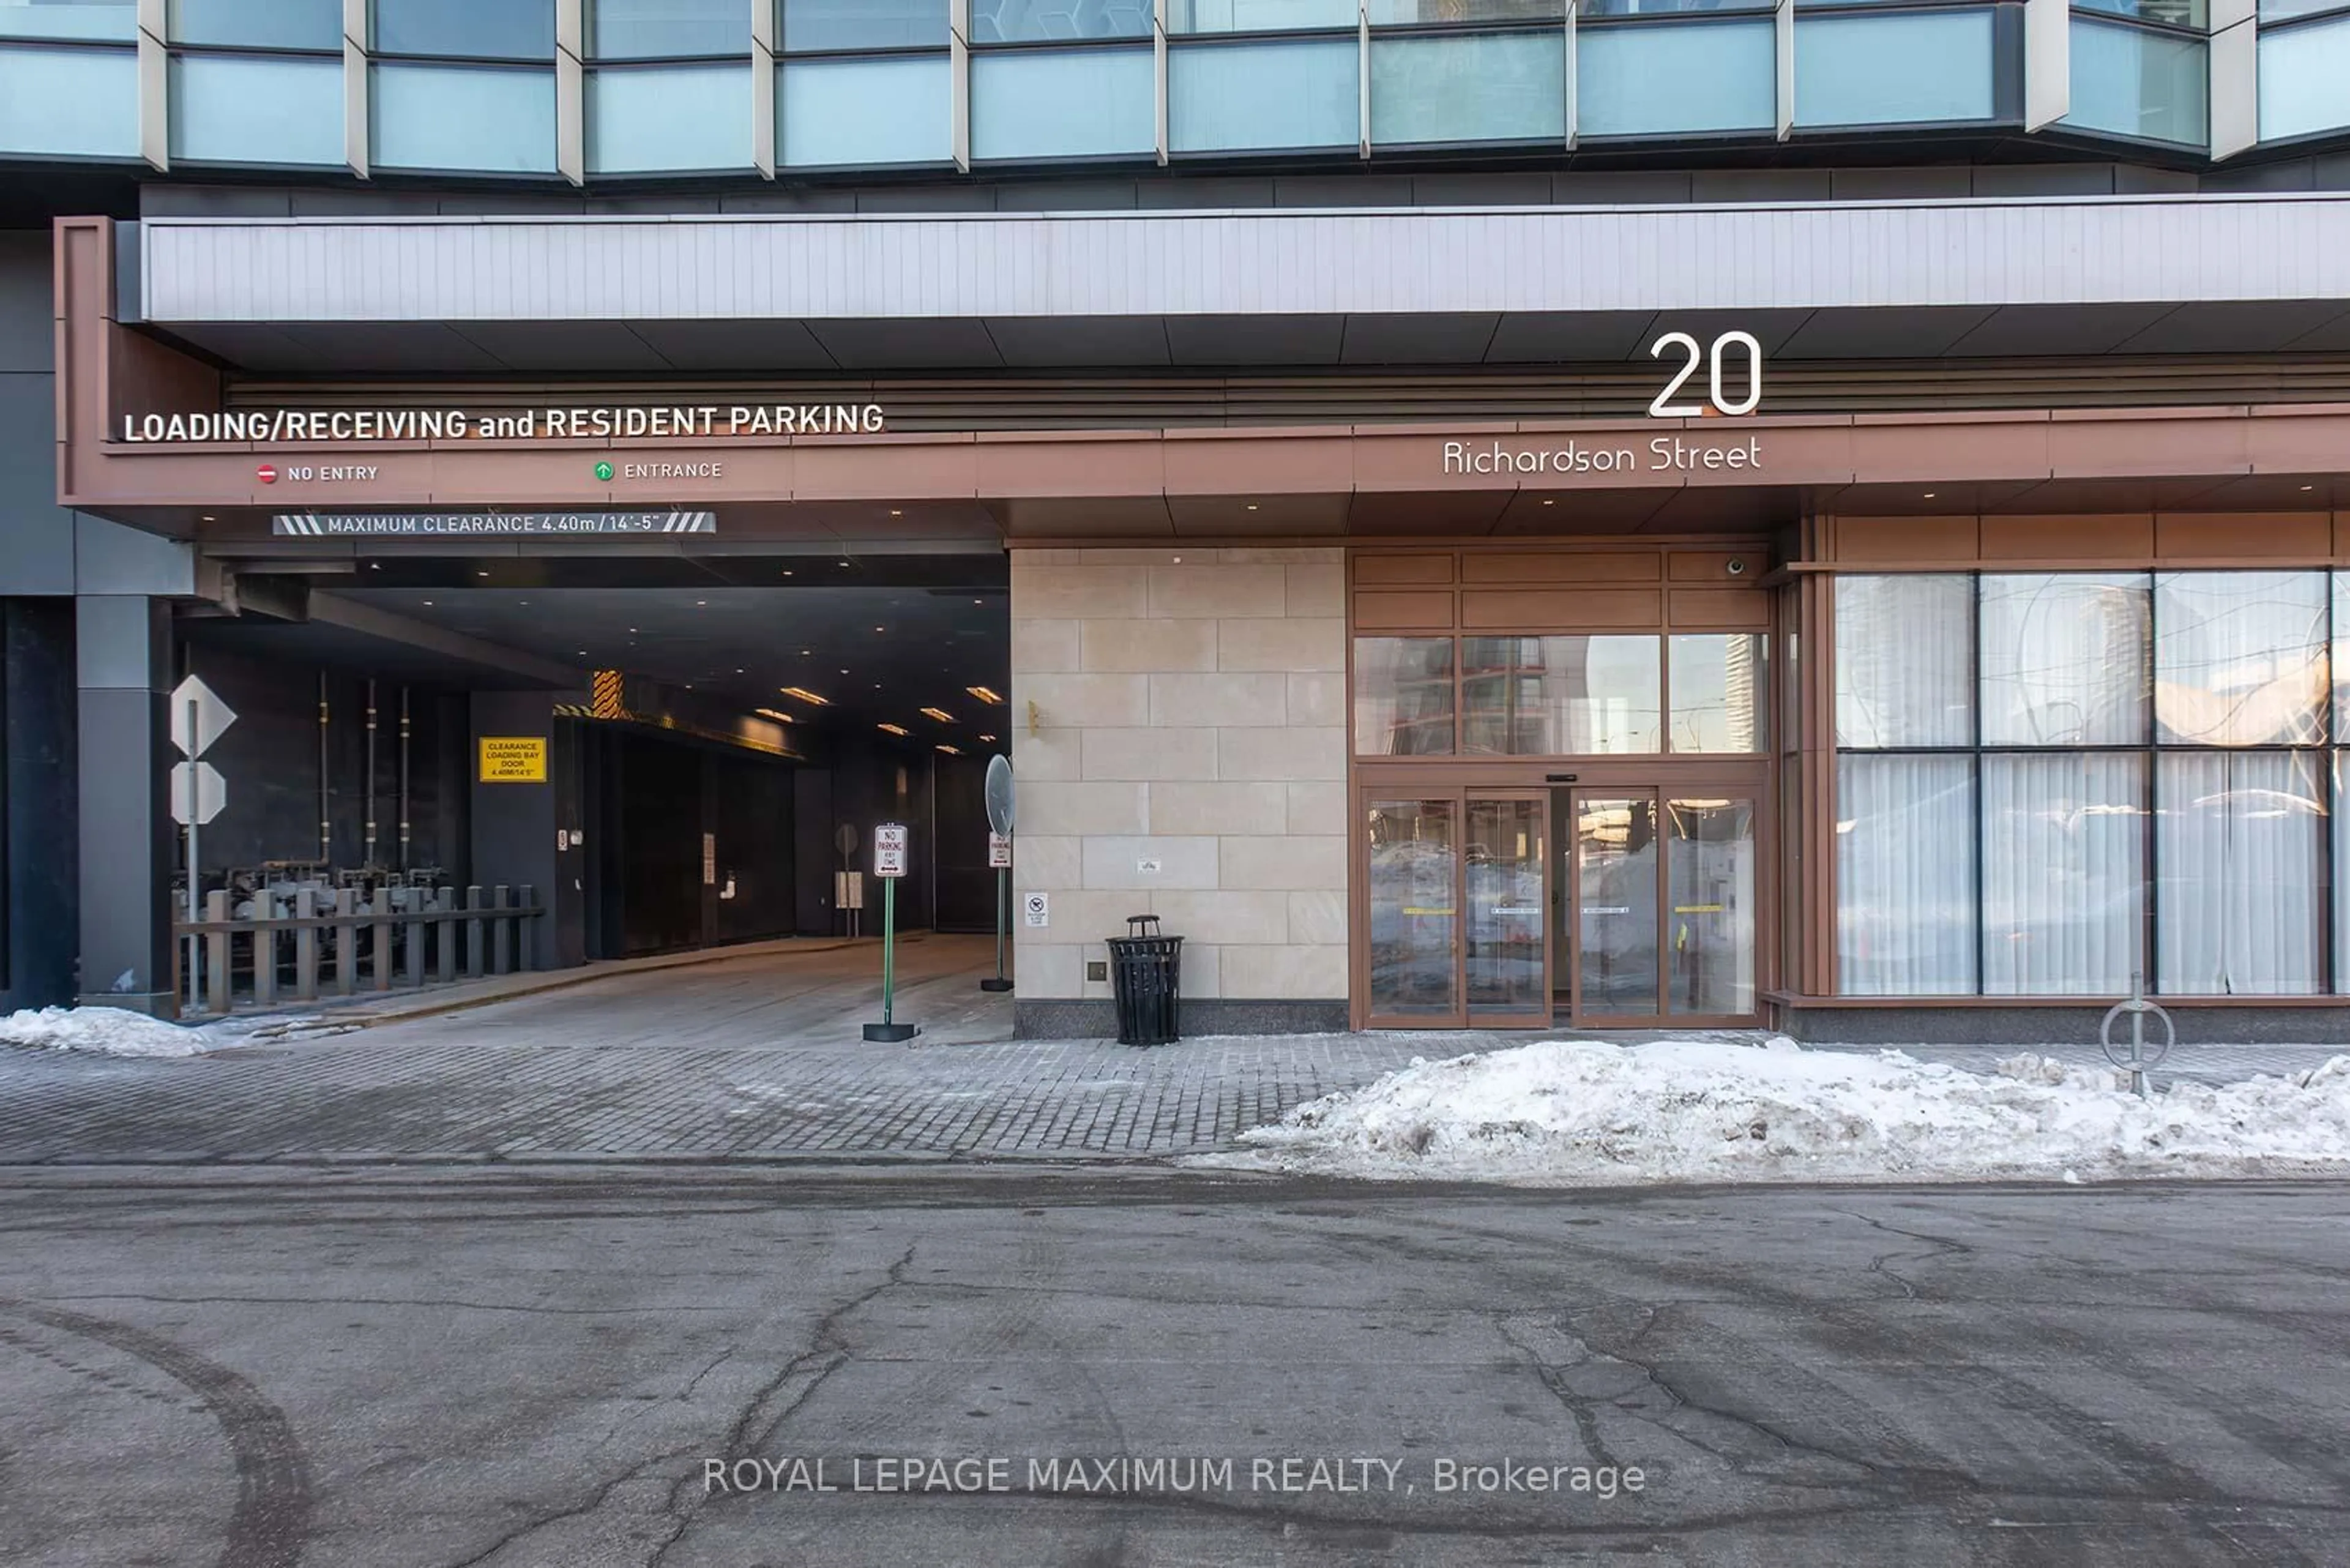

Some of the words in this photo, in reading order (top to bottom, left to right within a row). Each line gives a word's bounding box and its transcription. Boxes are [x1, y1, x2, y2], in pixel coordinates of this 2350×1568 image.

[1649, 330, 1762, 417] 20
[124, 409, 467, 442] LOADING/RECEIVING
[479, 410, 534, 438] and
[546, 407, 718, 436] RESIDENT
[731, 404, 885, 434] PARKING
[1444, 440, 1635, 474] Richardson
[1649, 436, 1761, 470] Street
[288, 466, 313, 480] NO
[320, 466, 378, 480] ENTRY
[625, 463, 722, 478] ENTRANCE
[328, 517, 416, 532] MAXIMUM
[423, 516, 534, 532] CLEARANCE
[884, 831, 896, 841] NO
